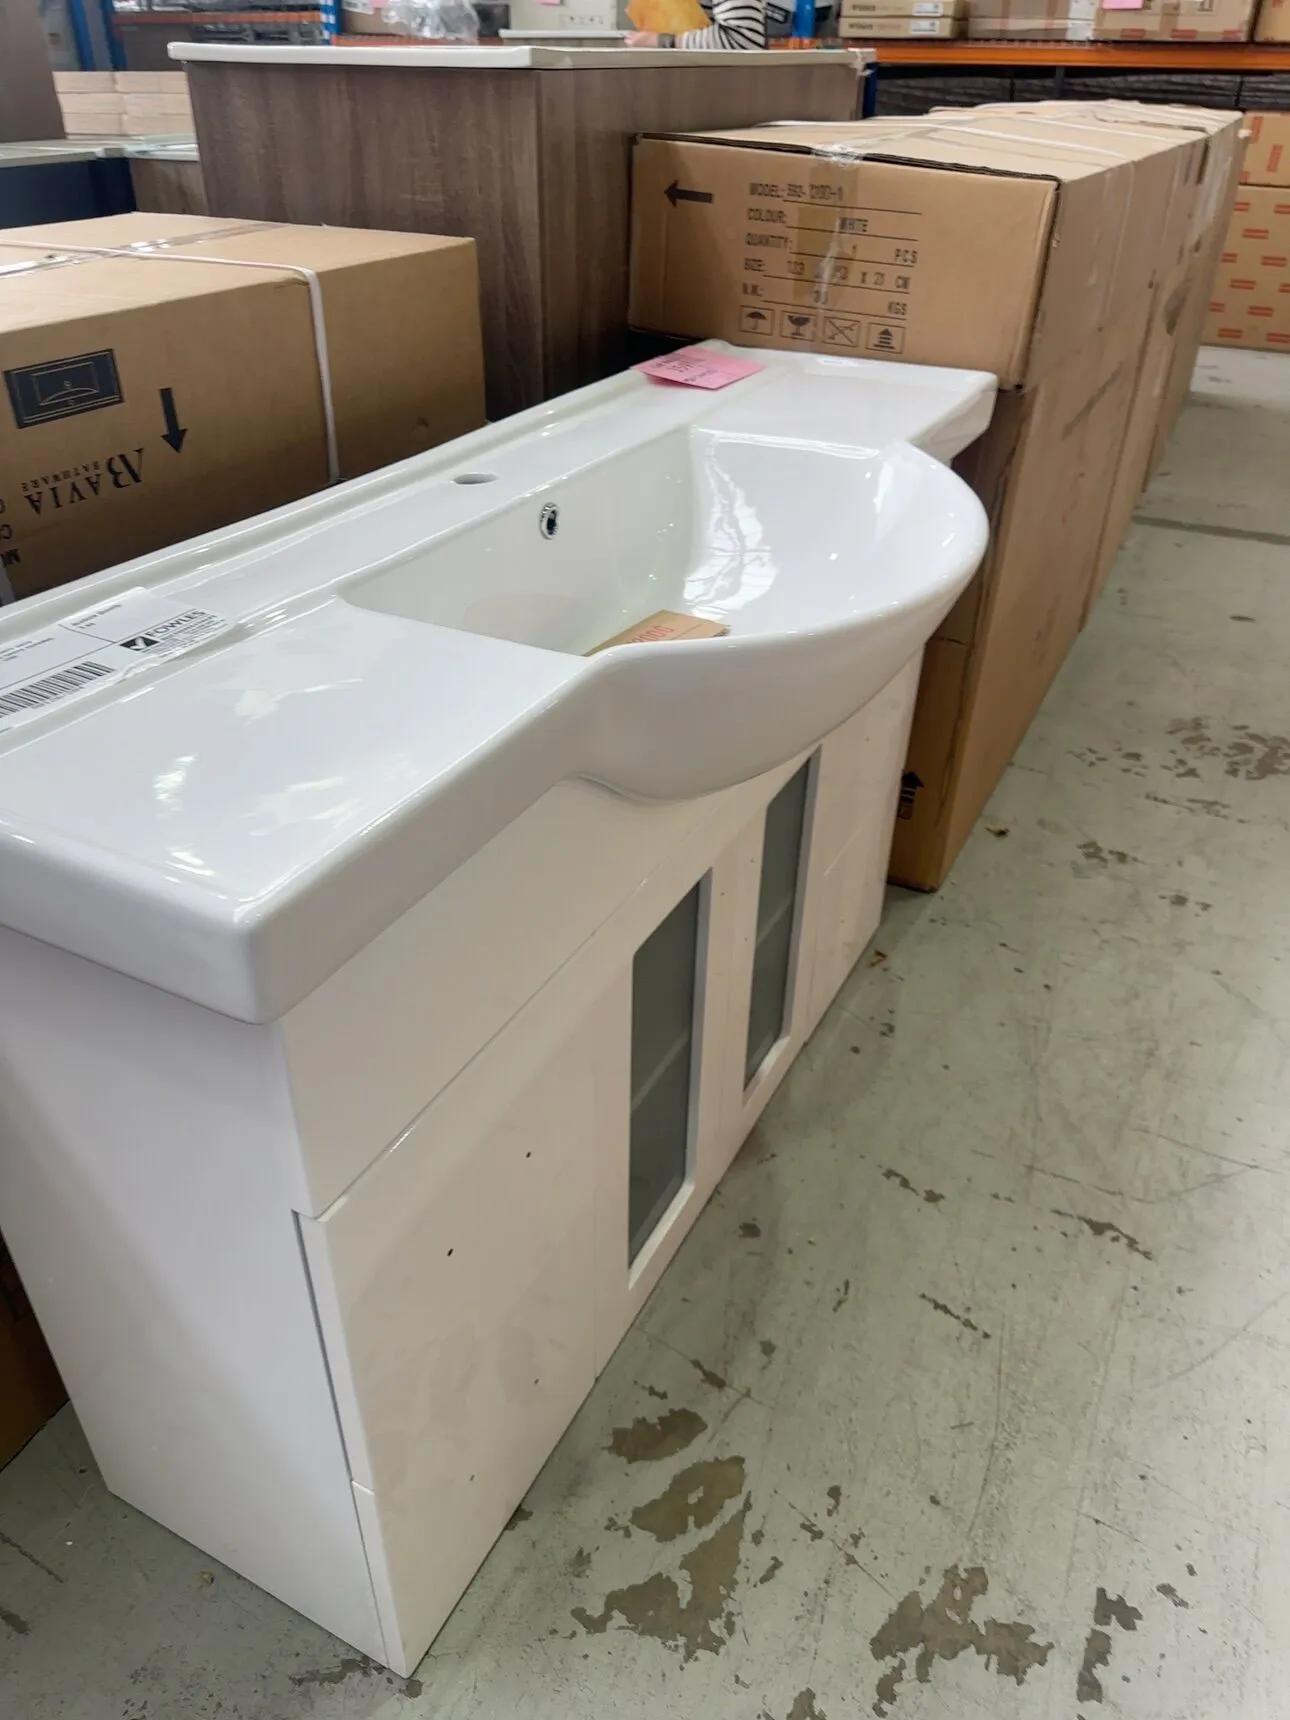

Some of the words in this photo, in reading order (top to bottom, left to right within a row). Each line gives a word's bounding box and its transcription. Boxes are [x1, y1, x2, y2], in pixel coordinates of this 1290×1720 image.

[750, 183, 784, 198] MODEL:
[748, 208, 787, 223] COLOUR:
[839, 217, 868, 232] WHITE
[746, 232, 792, 249] QUANTITY:
[744, 257, 765, 271] SIZE:
[146, 610, 206, 638] FOWLES
